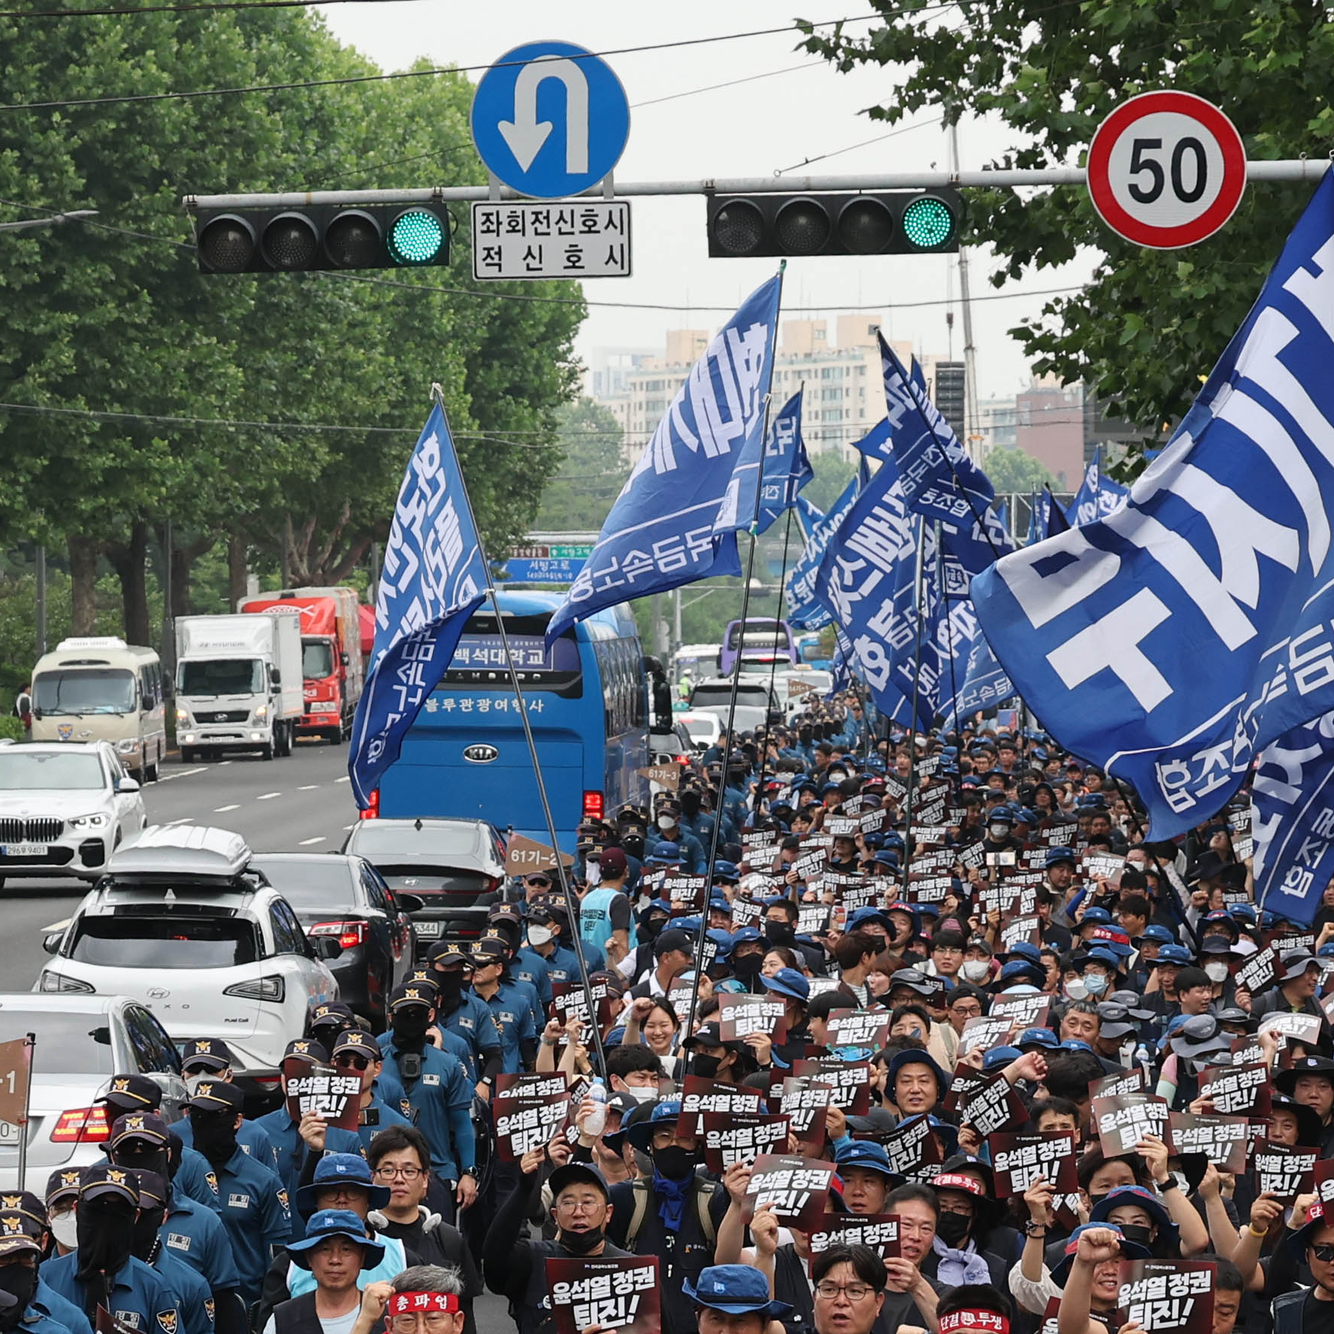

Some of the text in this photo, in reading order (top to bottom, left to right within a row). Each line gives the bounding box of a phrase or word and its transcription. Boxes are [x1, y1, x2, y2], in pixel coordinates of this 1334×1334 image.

[1128, 136, 1208, 205] 50
[480, 208, 624, 237] 좌회전신호시
[468, 749, 494, 760] KIA
[721, 1001, 785, 1023] 윤석열 정권
[827, 1012, 889, 1032] 윤석열 정권
[734, 1016, 777, 1036] 퇴진!
[835, 1026, 878, 1045] 퇴진!
[286, 1075, 362, 1098] 윤석열 정권
[299, 1096, 348, 1119] 퇴진!
[497, 1099, 568, 1138] 윤석열 정권
[510, 1125, 555, 1155] 퇴진!
[552, 1264, 656, 1305] 윤석열 정권
[1118, 1267, 1212, 1309] 윤석열 정권
[573, 1295, 640, 1332] 퇴진!
[976, 1312, 1007, 1332] 투쟁
[1127, 1297, 1194, 1333] 퇴진!
